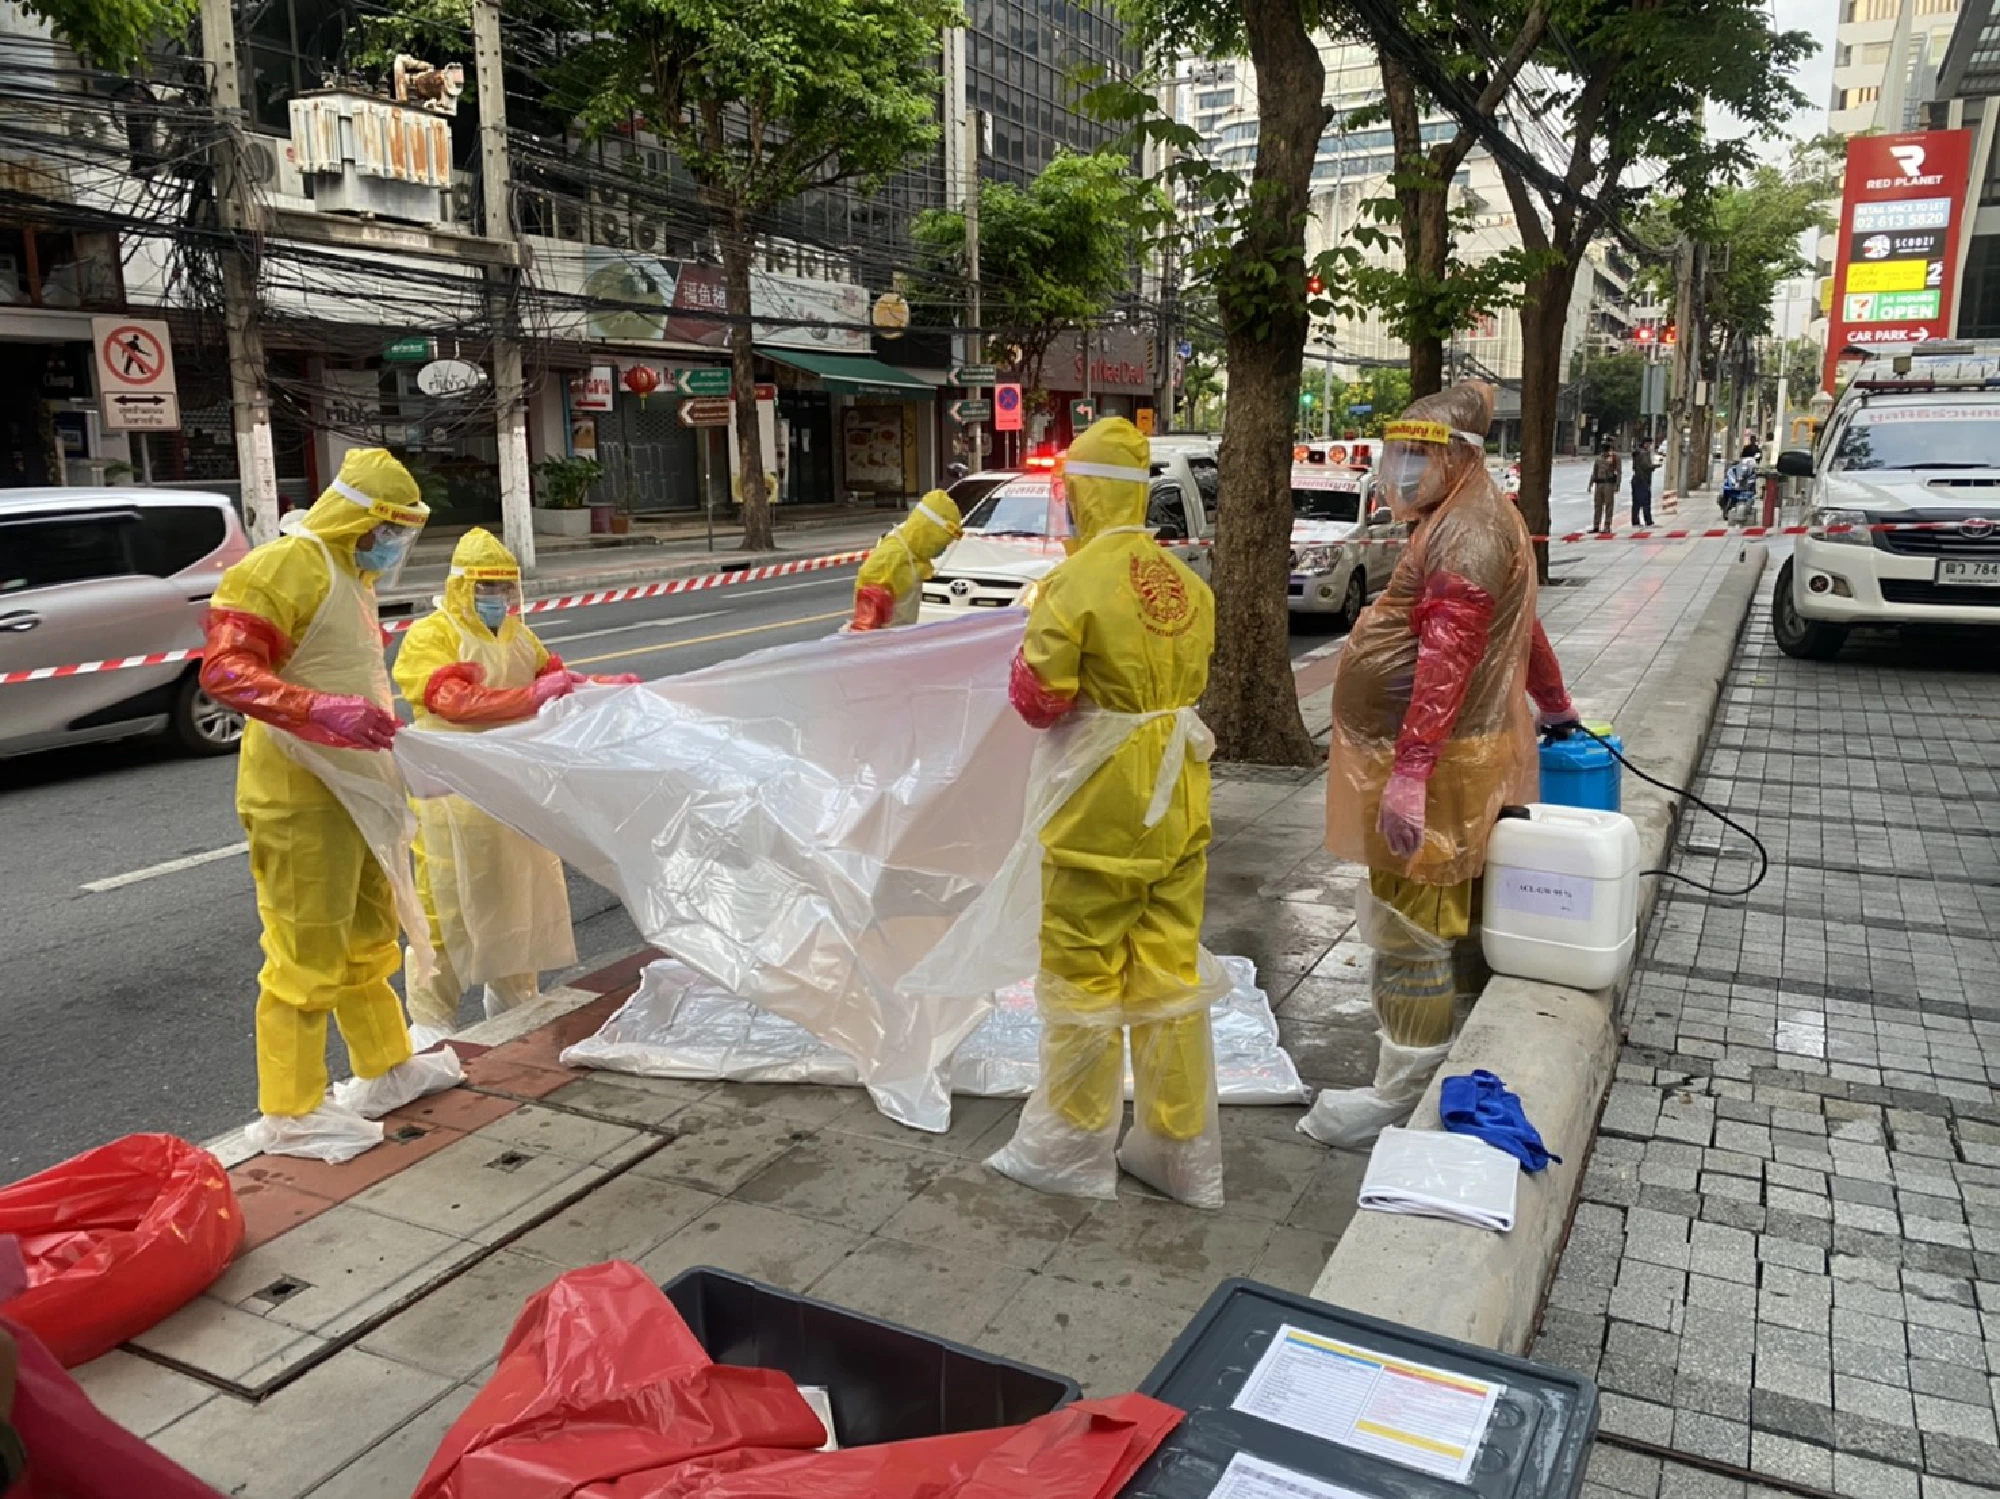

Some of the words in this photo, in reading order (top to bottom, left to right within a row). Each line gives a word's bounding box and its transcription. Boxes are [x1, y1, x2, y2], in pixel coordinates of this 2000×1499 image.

[1866, 178, 1891, 189] RED
[1895, 174, 1944, 187] PLANET
[1857, 205, 1885, 215] RETAIL
[1888, 202, 1913, 213] SPACE
[1916, 202, 1928, 212] TO
[1930, 201, 1944, 211] LET
[1857, 215, 1874, 228] 02
[1878, 214, 1905, 226] 613
[1909, 212, 1944, 225] 5820
[1880, 305, 1935, 319] OPEN
[1847, 331, 1872, 342] CAR
[1876, 330, 1909, 341] PARK
